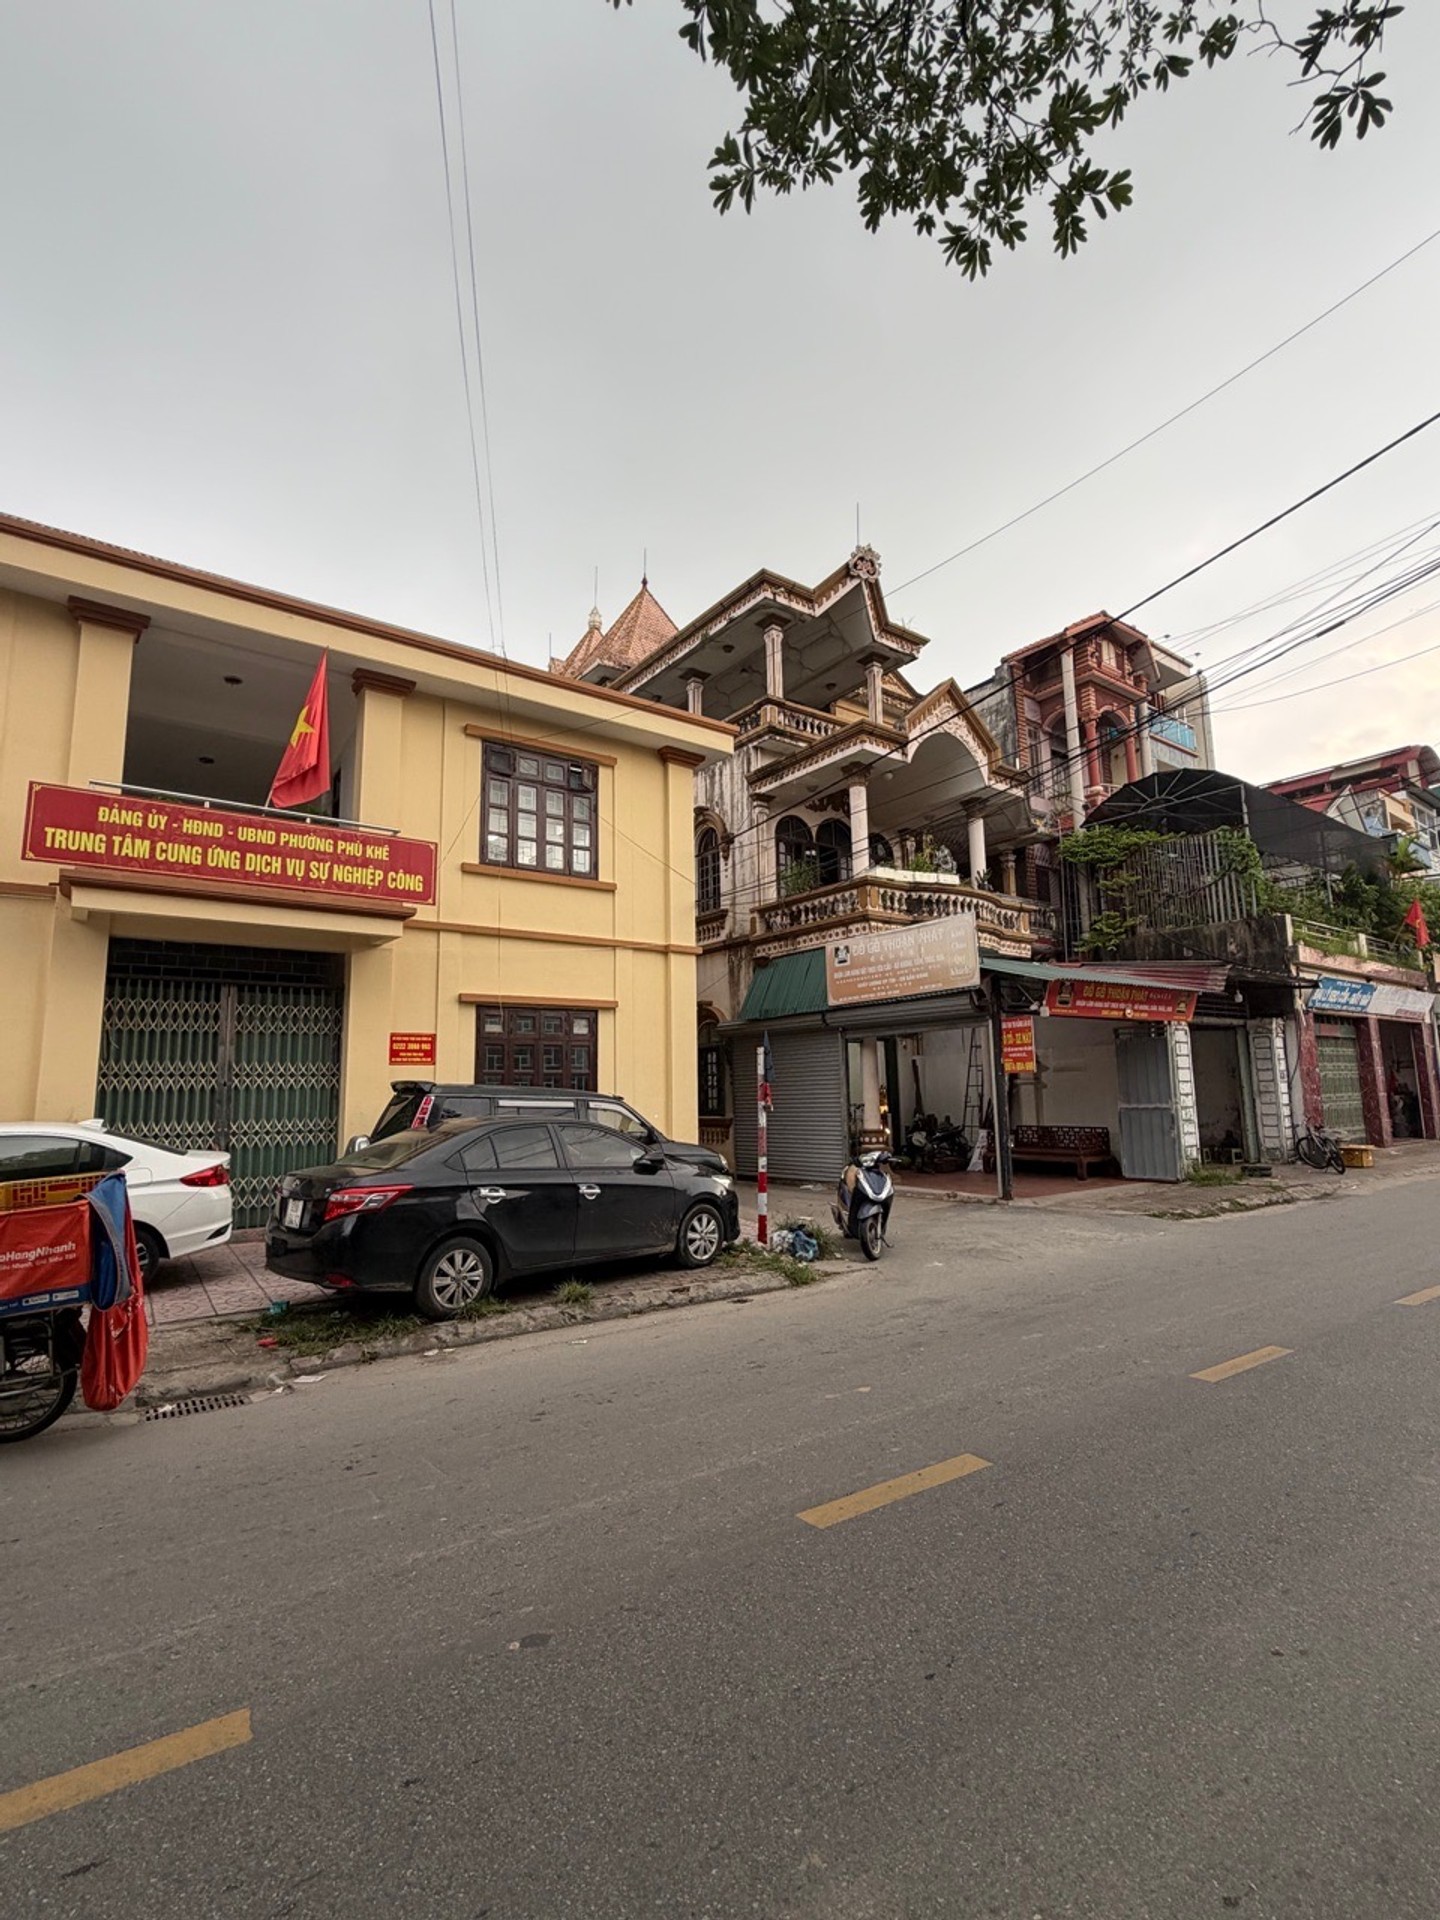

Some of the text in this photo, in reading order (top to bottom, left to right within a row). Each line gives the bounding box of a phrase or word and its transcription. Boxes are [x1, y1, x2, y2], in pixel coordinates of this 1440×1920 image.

[44, 827, 424, 892] TRUNG TÂM CUNG ỨNG DỊCH VỤ SỰ NGHIỆP CÔNG
[98, 803, 143, 827] ĐẢNG
[147, 808, 168, 830] ỦY
[182, 818, 224, 838] HĐND
[237, 826, 276, 845] UBND
[279, 832, 334, 853] PHƯỜNG
[337, 839, 363, 858] PHÙ
[365, 845, 390, 861] KHÊ
